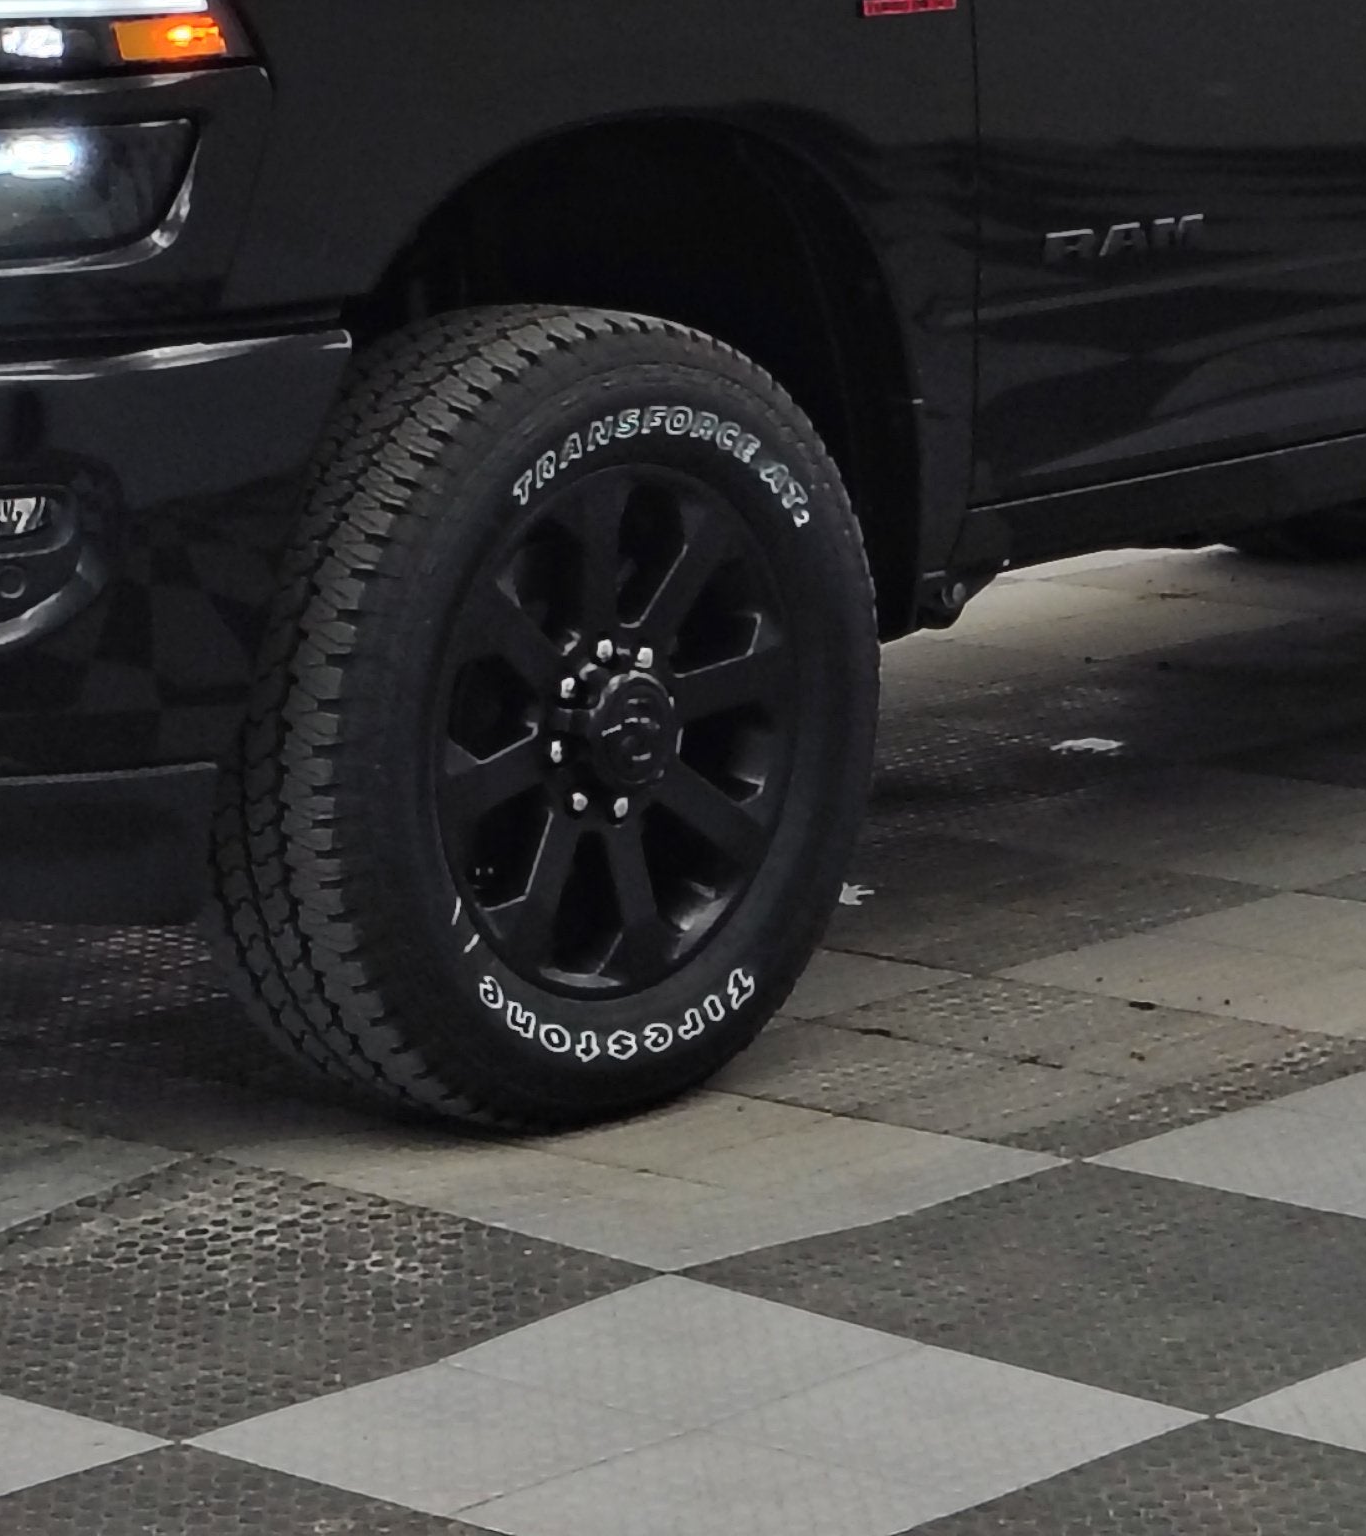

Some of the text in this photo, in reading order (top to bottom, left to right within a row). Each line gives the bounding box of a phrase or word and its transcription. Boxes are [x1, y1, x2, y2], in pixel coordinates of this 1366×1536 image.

[1041, 213, 1205, 265] RAM
[511, 405, 761, 506] TRANSFORCE
[479, 967, 756, 1063] Firestone
